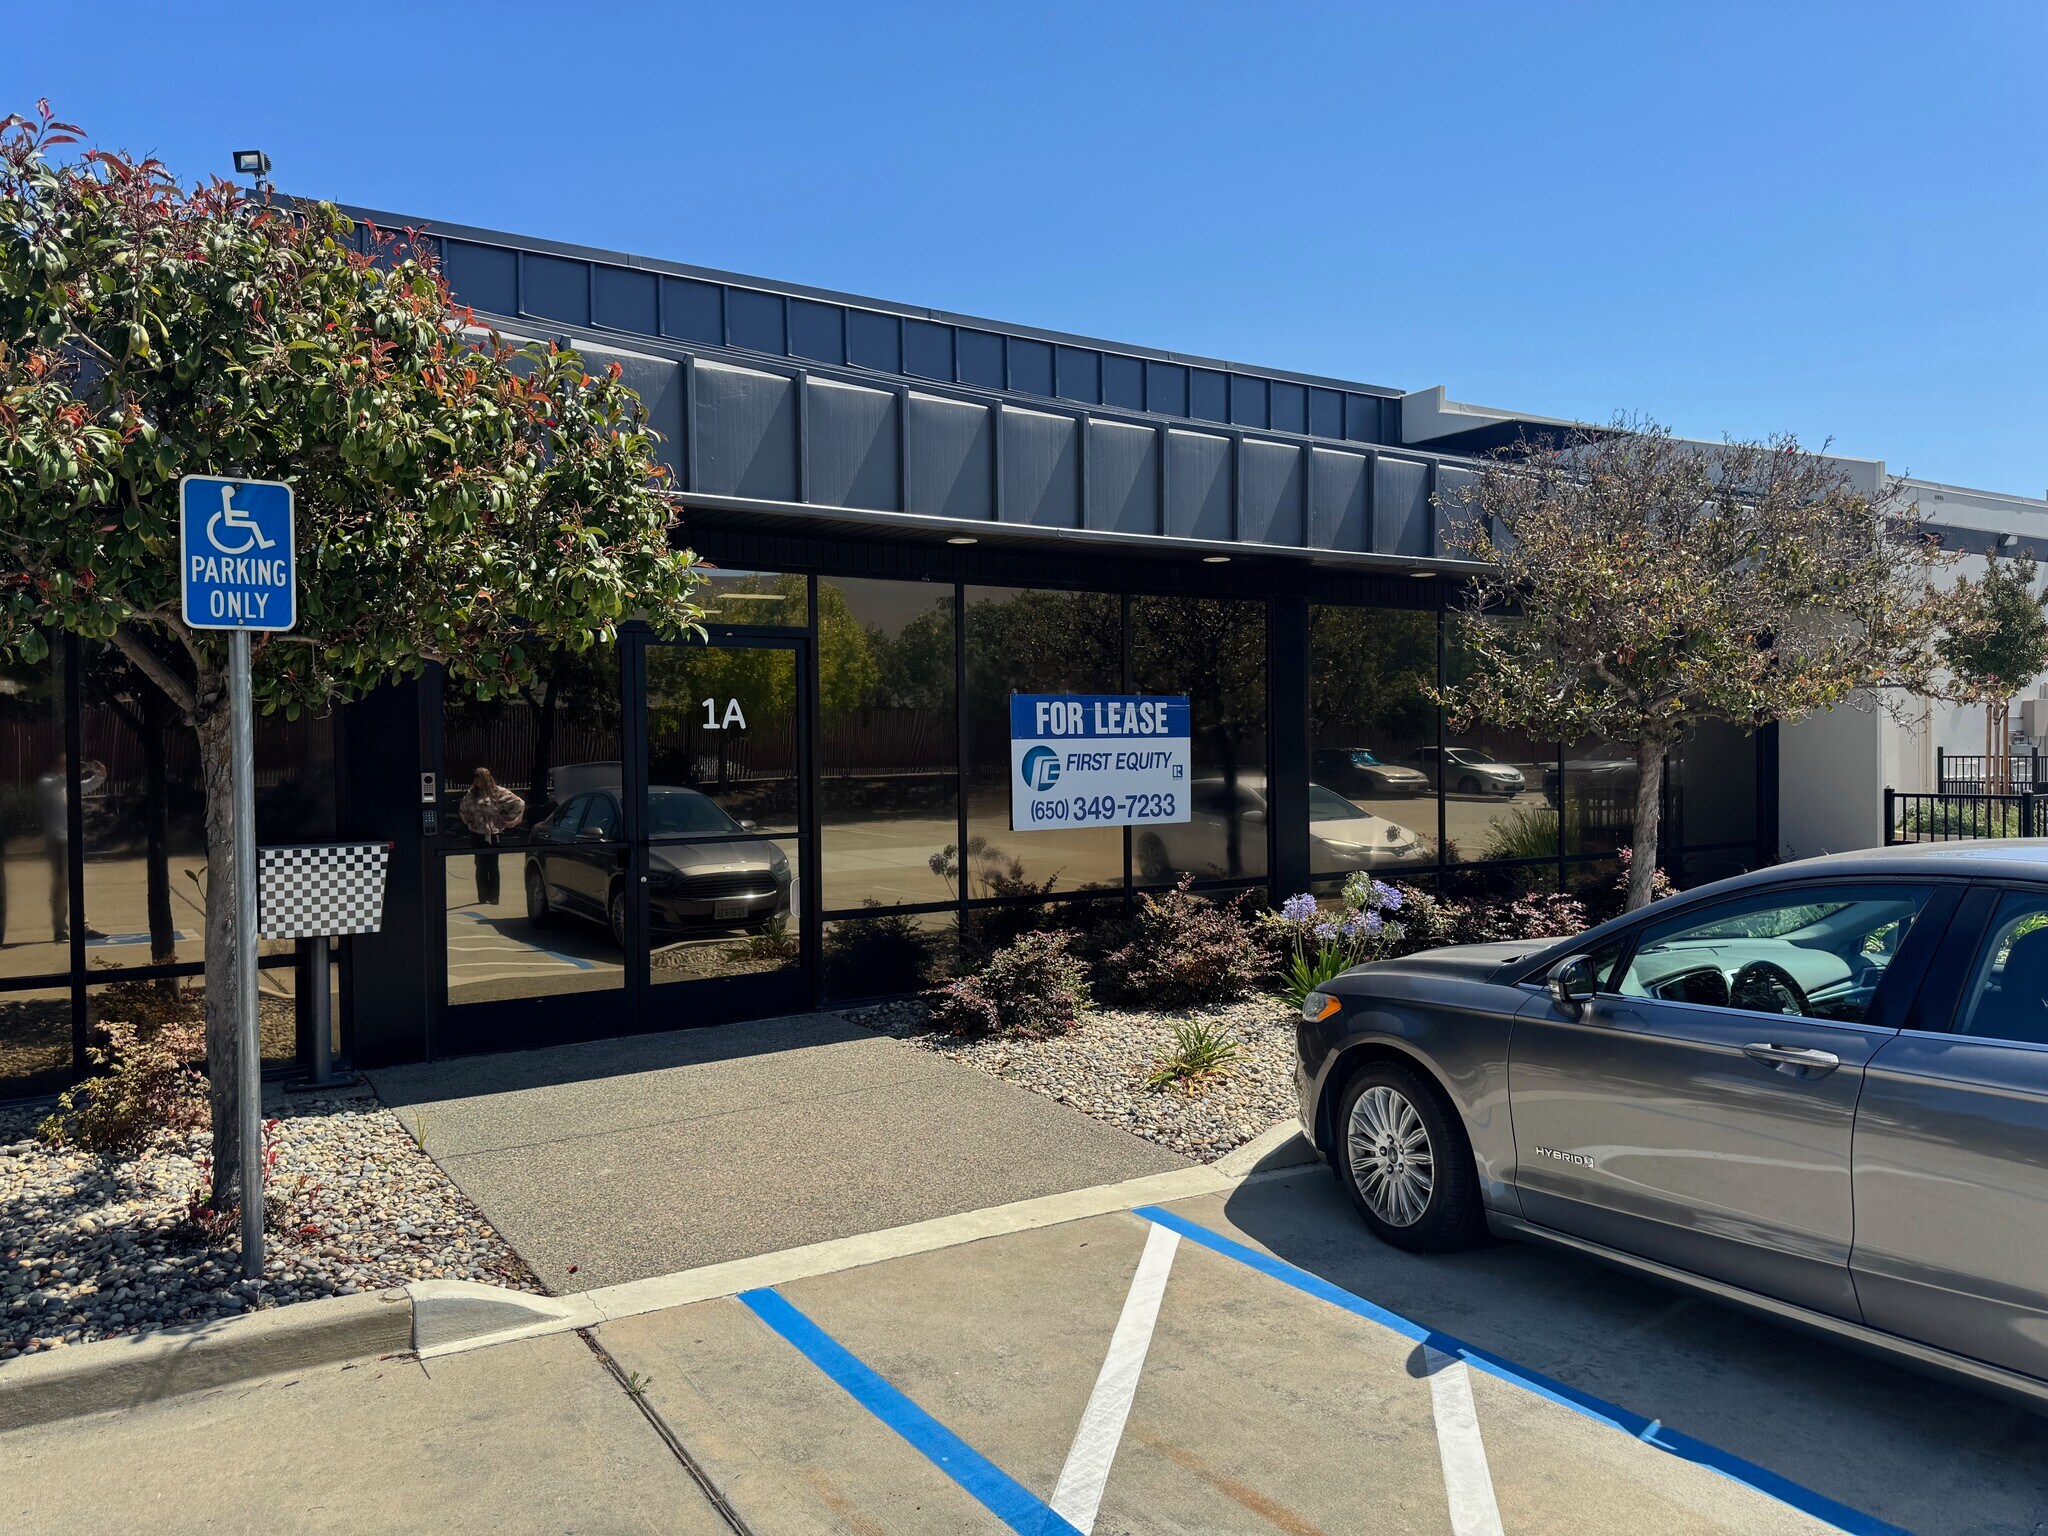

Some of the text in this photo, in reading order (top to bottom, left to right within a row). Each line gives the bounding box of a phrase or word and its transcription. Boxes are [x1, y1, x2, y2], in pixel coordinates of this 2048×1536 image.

[191, 555, 286, 587] PARKING
[210, 589, 270, 619] ONLY
[701, 697, 747, 730] 1A
[1035, 701, 1169, 735] FOR LEASE
[1066, 751, 1173, 772] FIRST EQUITY
[1030, 792, 1176, 823] (650) 349-7233
[1535, 1146, 1583, 1165] HYBRID
